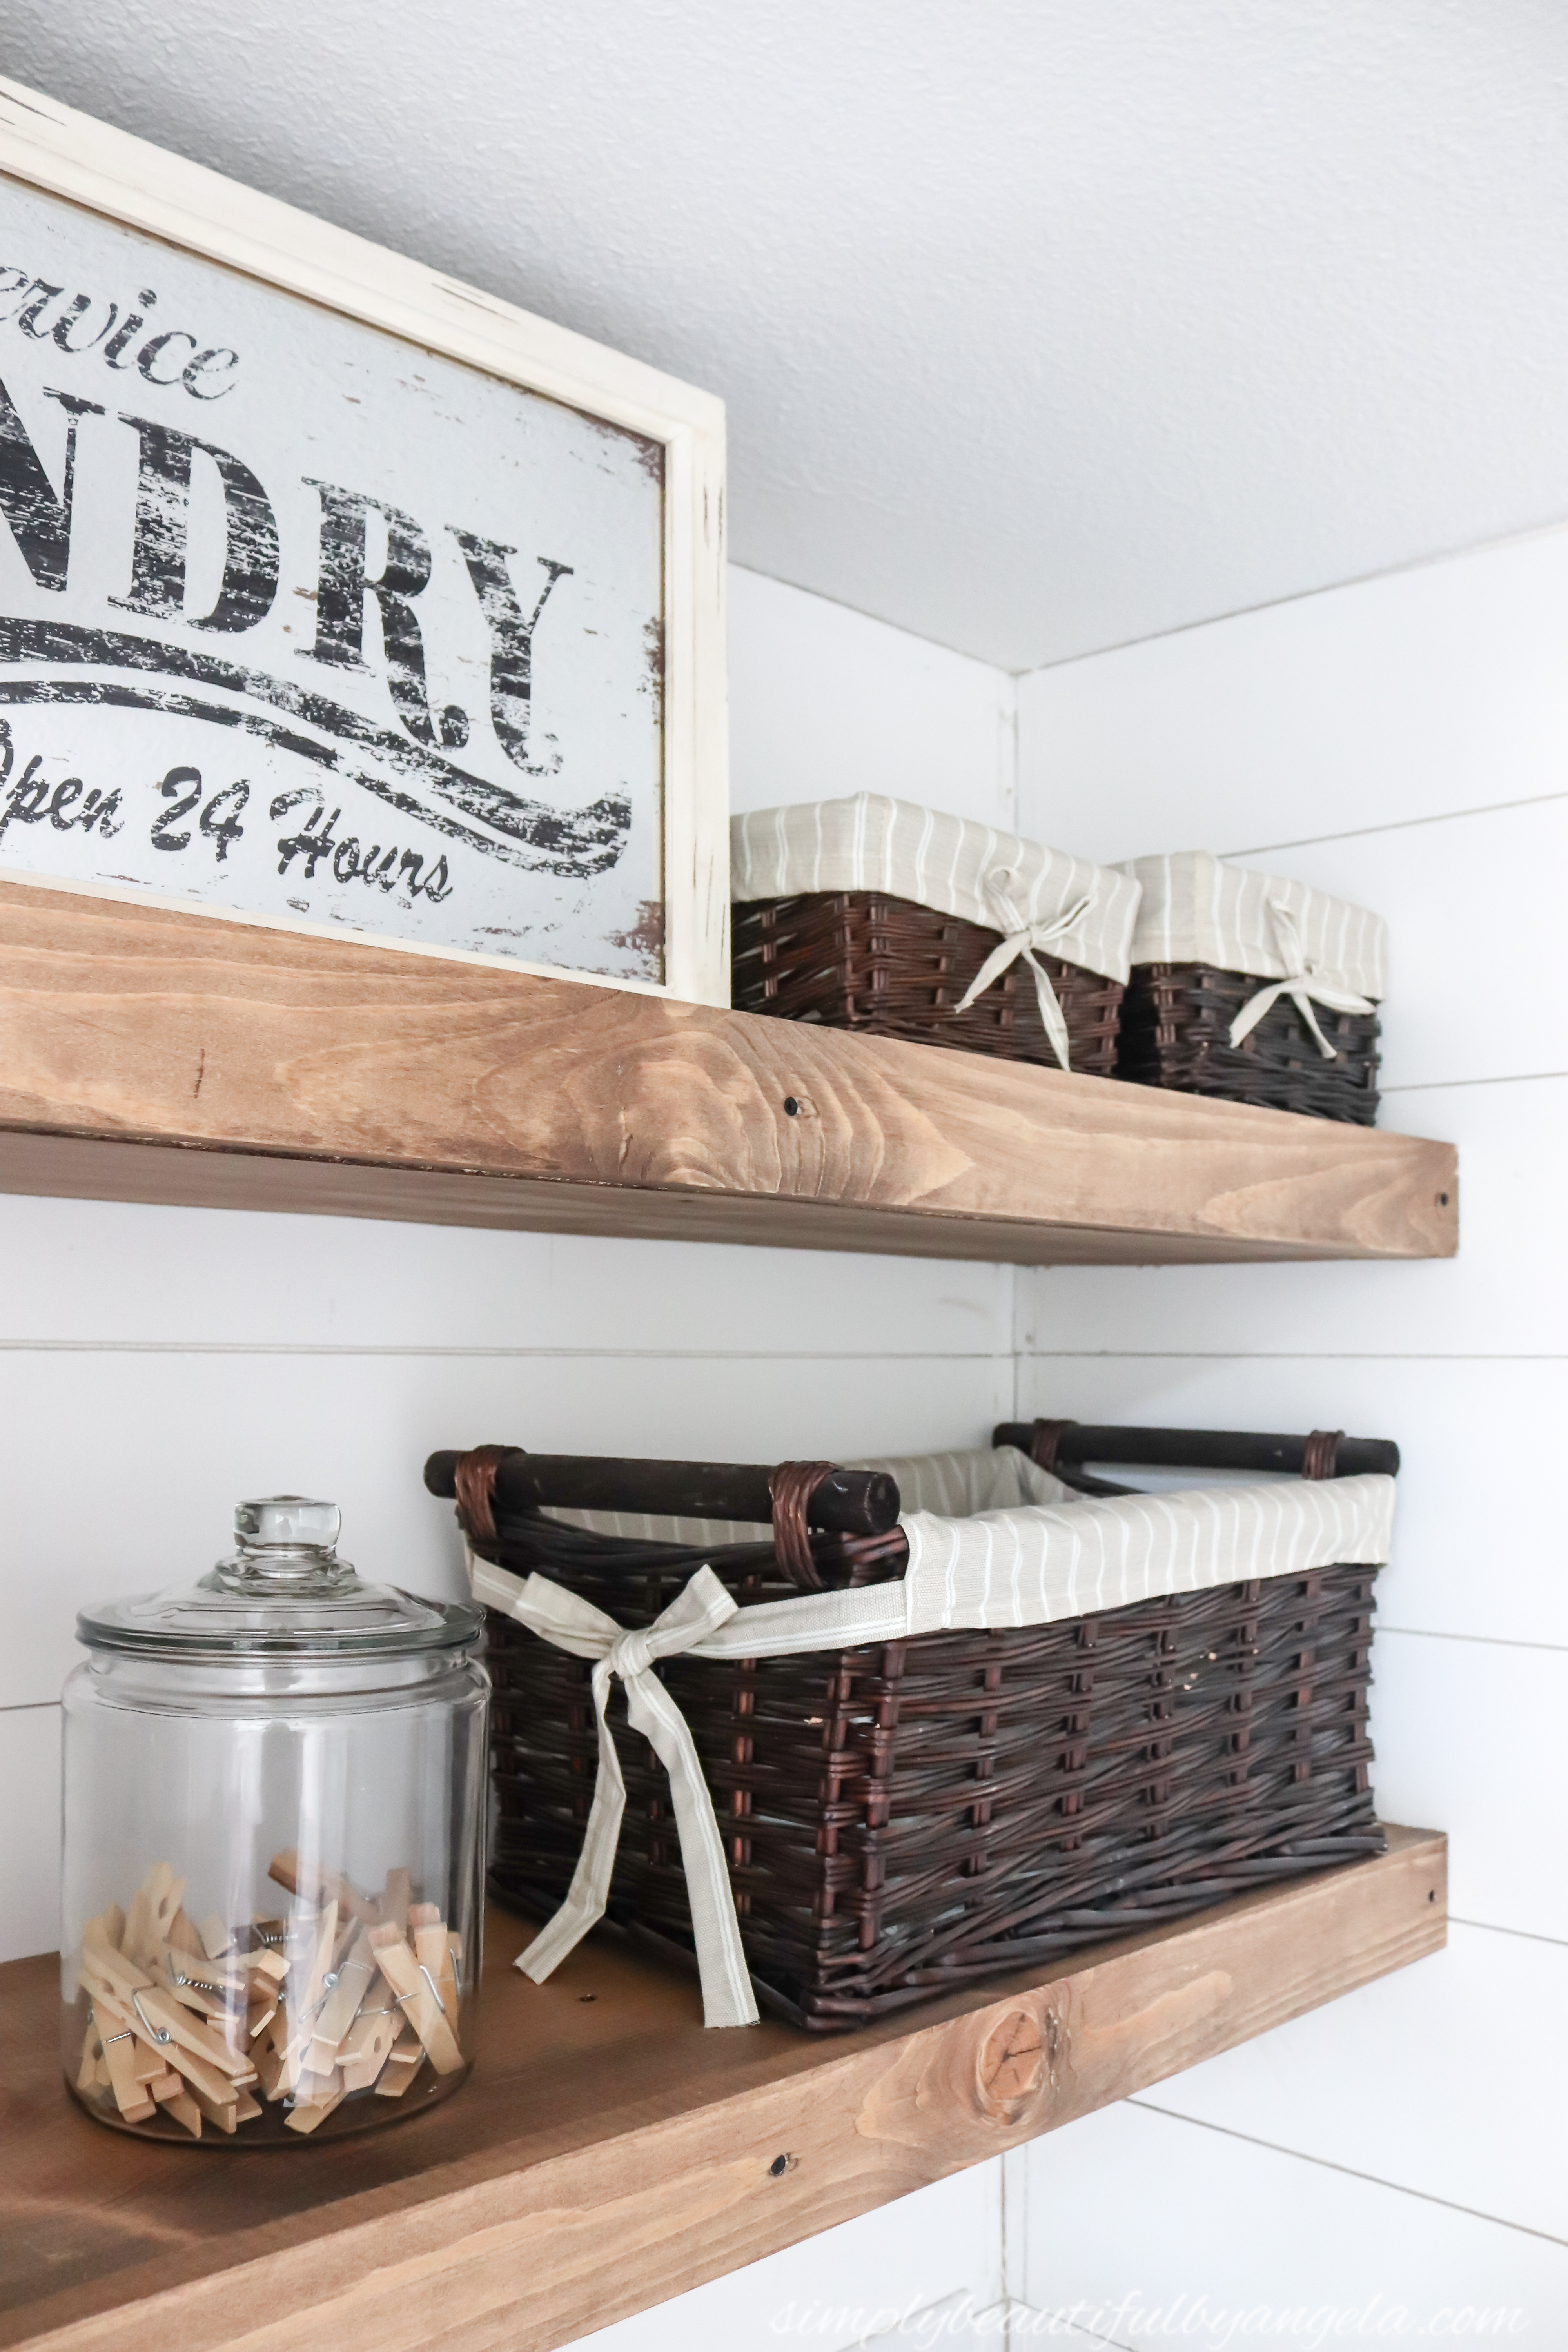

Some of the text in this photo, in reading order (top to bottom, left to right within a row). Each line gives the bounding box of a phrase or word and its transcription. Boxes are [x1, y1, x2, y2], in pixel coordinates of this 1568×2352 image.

[0, 719, 454, 903] pen 24 Hours
